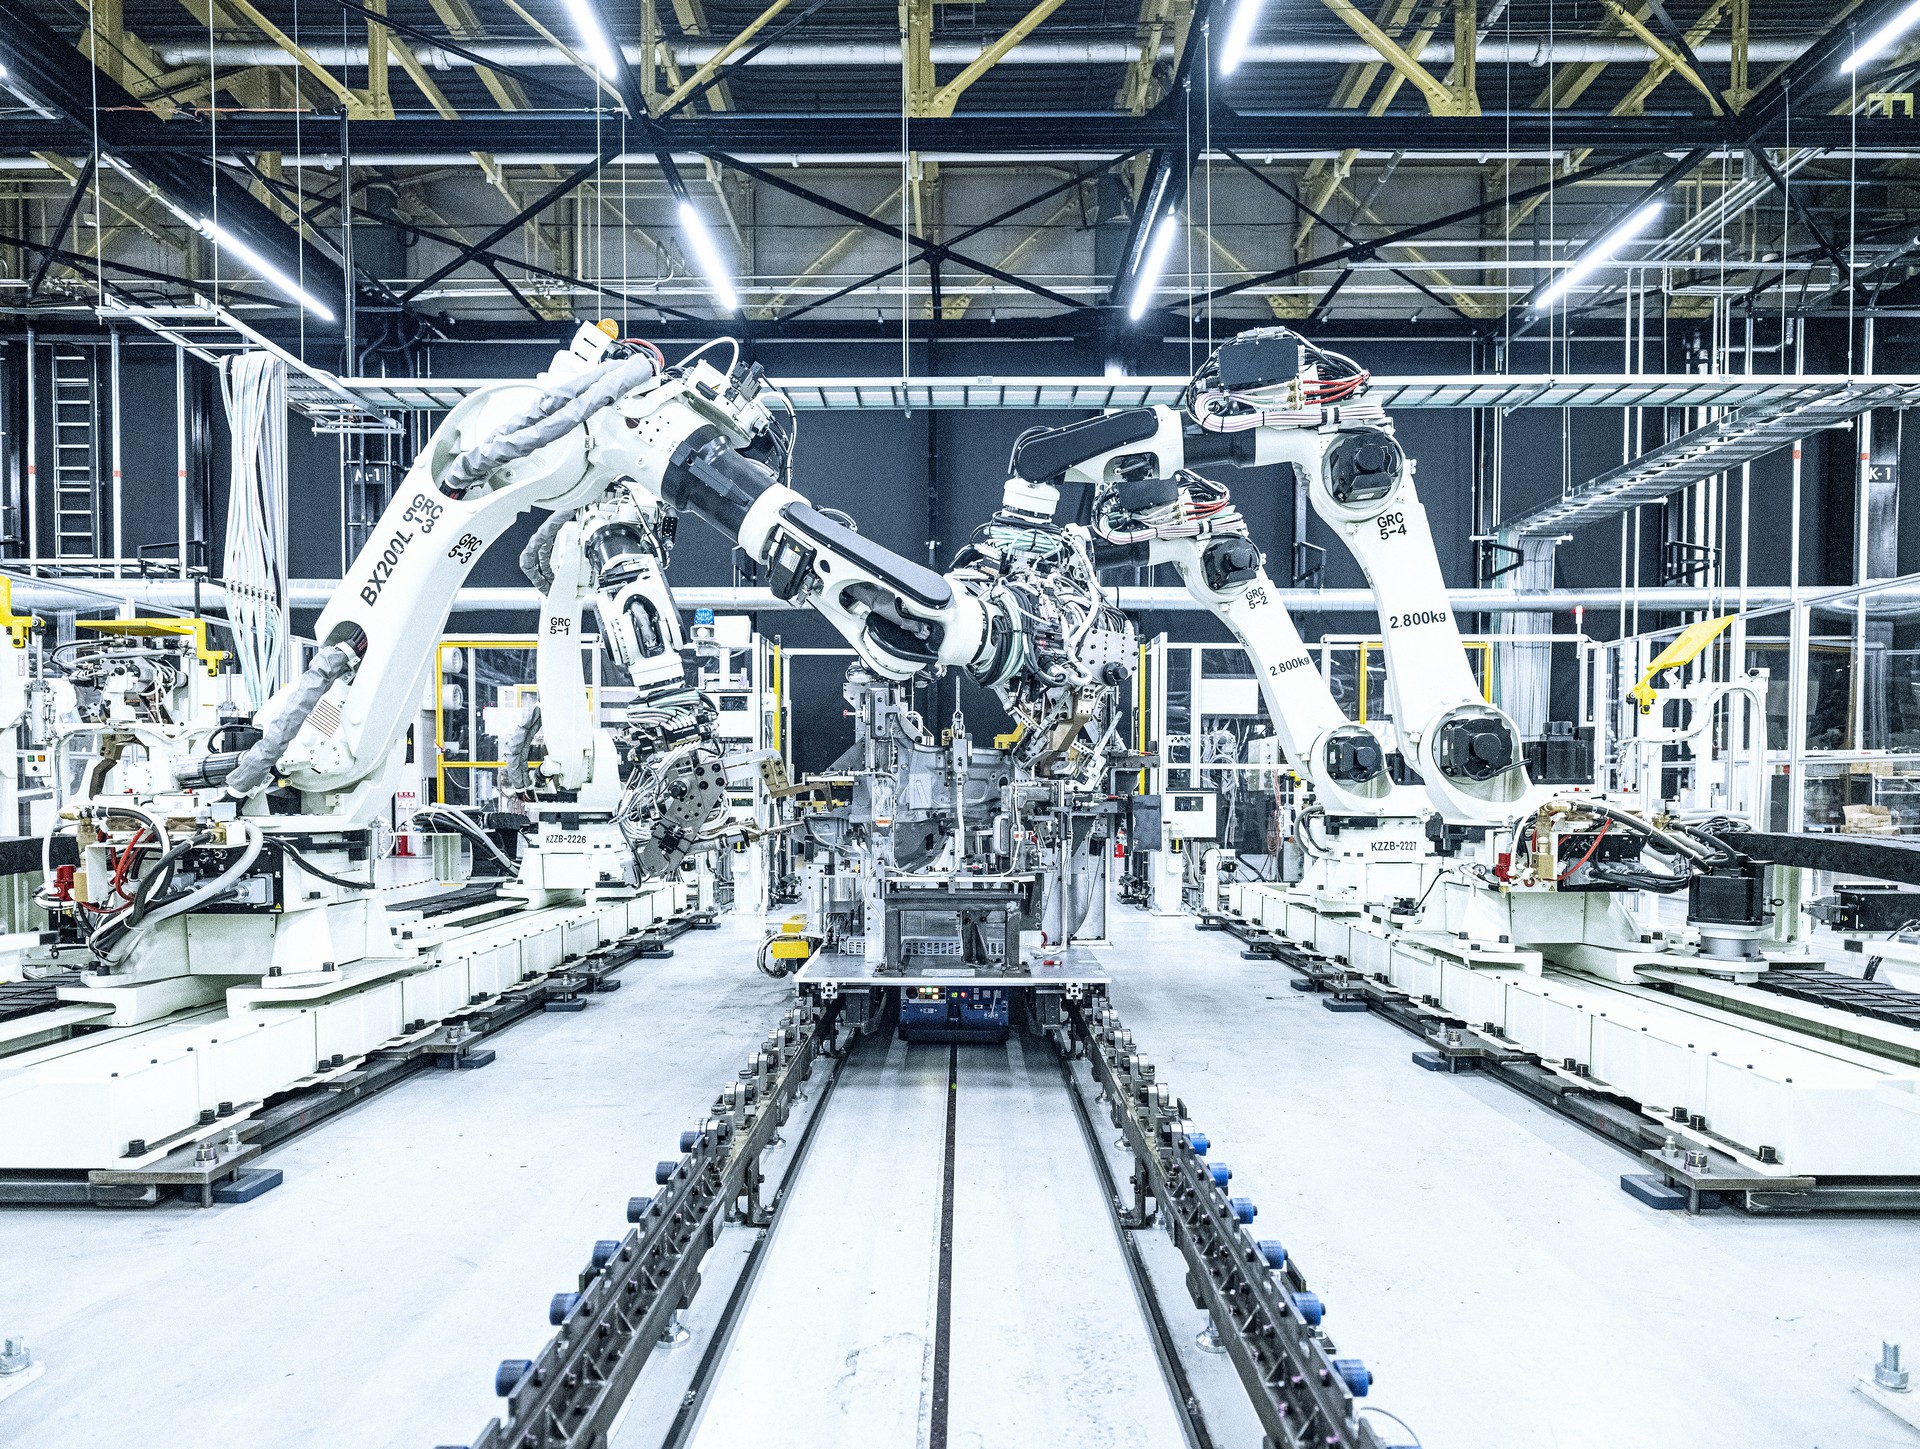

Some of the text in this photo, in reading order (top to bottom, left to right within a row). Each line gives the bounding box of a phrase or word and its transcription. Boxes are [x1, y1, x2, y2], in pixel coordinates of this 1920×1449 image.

[1869, 467, 1891, 480] K-1
[412, 493, 443, 520] GRC
[402, 507, 435, 534] 5-3
[1377, 512, 1404, 528] GRC
[1380, 524, 1407, 540] 5-4
[458, 533, 483, 552] GRC
[447, 545, 473, 564] 5-3
[360, 530, 414, 607] BX200L
[1245, 586, 1265, 601] GRC
[1248, 595, 1269, 609] 5-2
[550, 616, 571, 627] GRC
[1389, 611, 1447, 629] 2.800kg
[549, 625, 569, 636] 5-1
[1269, 656, 1311, 676] 2.800kg
[545, 834, 587, 844] KZZB-2226
